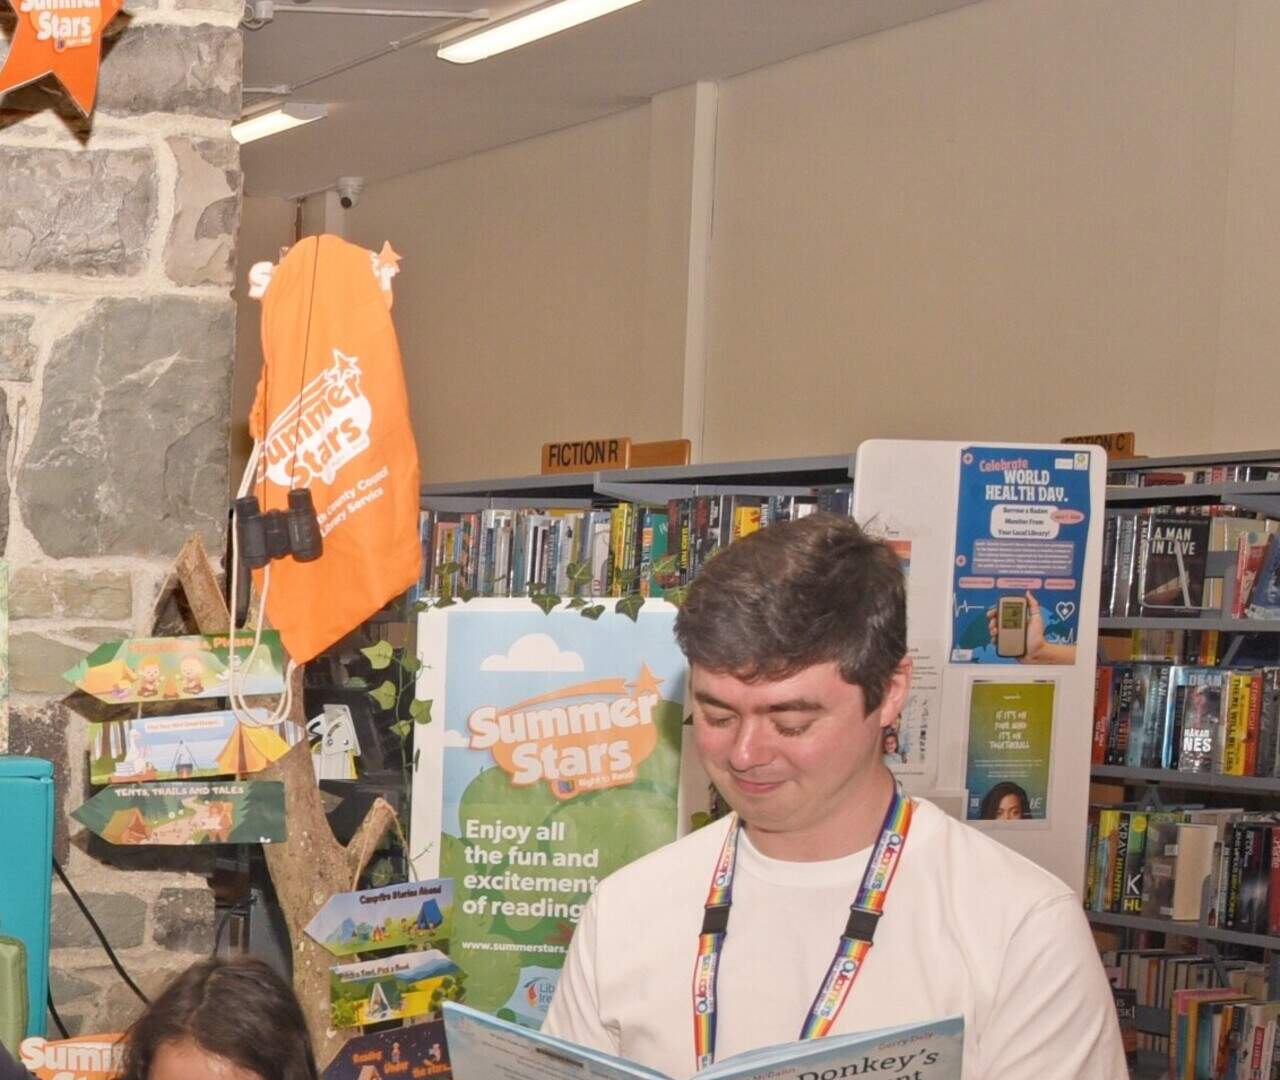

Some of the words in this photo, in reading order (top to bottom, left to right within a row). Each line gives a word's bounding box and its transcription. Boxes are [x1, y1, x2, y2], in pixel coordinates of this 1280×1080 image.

[37, 11, 92, 41] Stars
[257, 372, 363, 484] Summer
[284, 414, 364, 488] Stars
[548, 441, 606, 468] FICTION
[608, 439, 619, 464] R
[1116, 433, 1126, 452] C
[1004, 470, 1050, 485] WORLD
[985, 484, 1037, 501] HEALTH
[1038, 486, 1069, 502] DAY.
[1166, 527, 1192, 541] MAN
[1151, 541, 1165, 554] IN
[1168, 541, 1196, 556] LVE
[469, 693, 660, 749] Summer
[511, 737, 632, 785] Stars
[151, 786, 188, 796] TRAILS
[189, 786, 210, 796] AND
[212, 786, 245, 796] TALES
[465, 819, 531, 843] Enjoy
[536, 821, 565, 841] all
[464, 847, 503, 866] the
[507, 847, 547, 867] fun
[553, 848, 600, 869] and
[463, 872, 600, 894] excitement
[359, 892, 391, 905] Campfire
[392, 888, 418, 900] Stories
[418, 885, 442, 897] Ahead
[462, 896, 485, 916] of
[491, 896, 584, 925] reading
